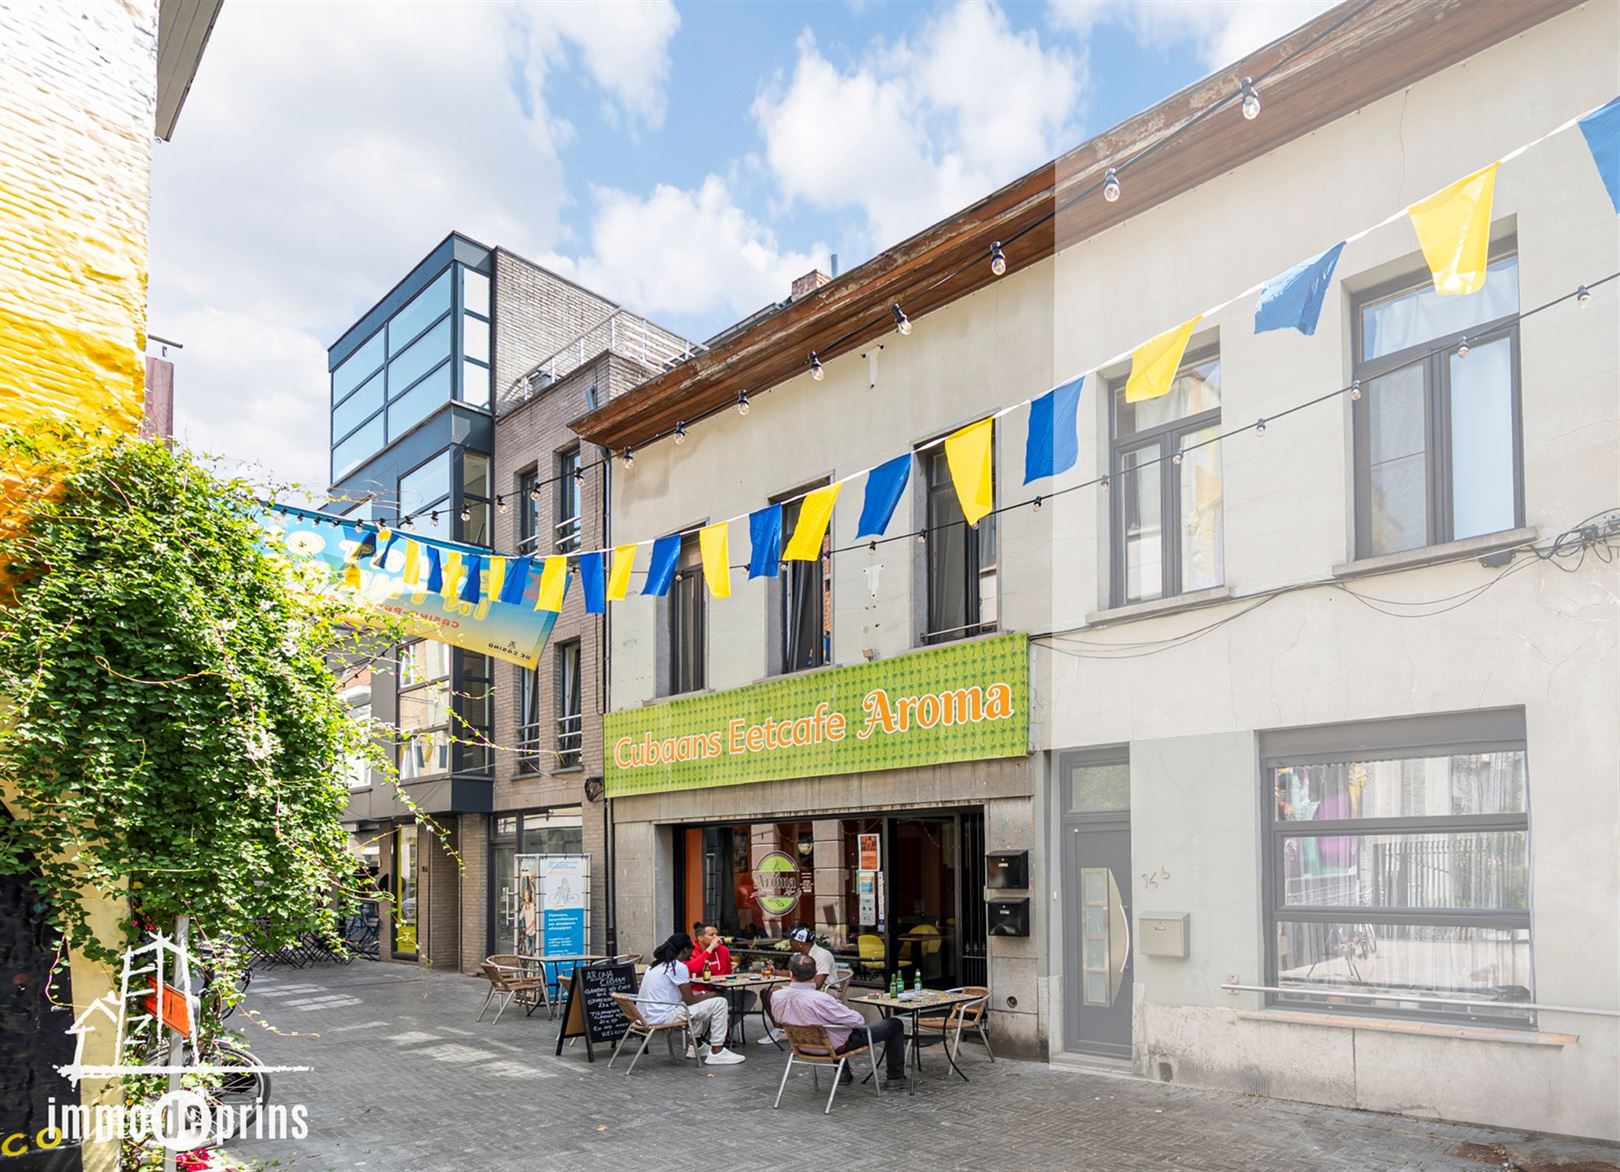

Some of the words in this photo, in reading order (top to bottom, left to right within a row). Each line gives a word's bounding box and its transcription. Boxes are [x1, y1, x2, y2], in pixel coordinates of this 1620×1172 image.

[614, 732, 721, 769] Cubaans
[729, 702, 846, 755] Eetcafe
[857, 683, 1014, 739] Aroma
